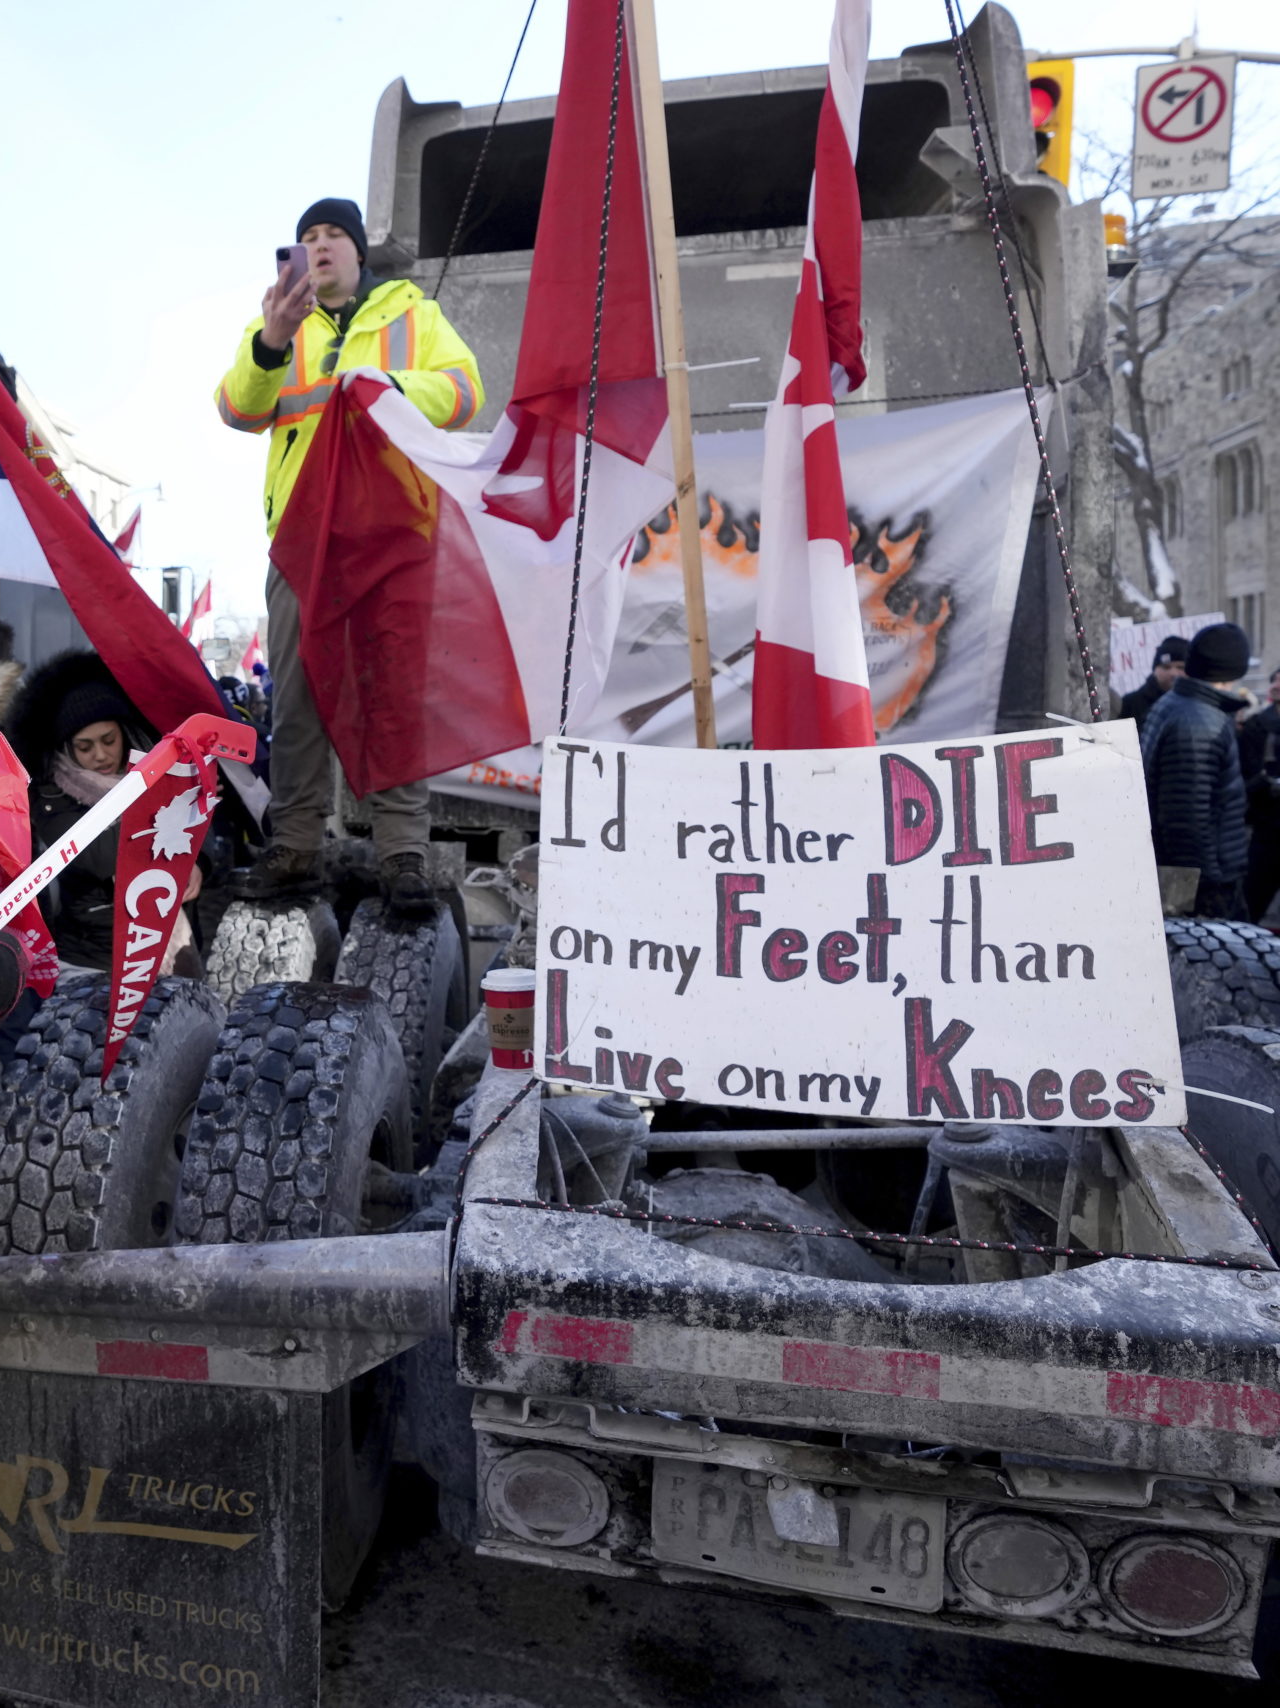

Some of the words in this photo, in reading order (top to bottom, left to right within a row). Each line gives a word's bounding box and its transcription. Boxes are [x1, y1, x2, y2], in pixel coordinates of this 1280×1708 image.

[550, 743, 626, 852] I'd
[677, 761, 855, 864] rather
[880, 737, 1075, 868] DIE
[108, 868, 178, 1044] CANADA
[549, 925, 613, 965] on
[629, 938, 702, 996] my
[715, 872, 908, 997] Feet,
[929, 874, 1096, 984] than
[544, 968, 686, 1101] Live
[717, 1063, 786, 1101] on
[798, 1073, 882, 1116] my
[904, 997, 1156, 1123] Knees
[126, 1472, 257, 1518] TRUCKS
[696, 1483, 931, 1580] PA148
[30, 1573, 44, 1595] &
[52, 1578, 100, 1606] SELL
[107, 1588, 167, 1618] USED
[174, 1599, 264, 1635] TRUCKS
